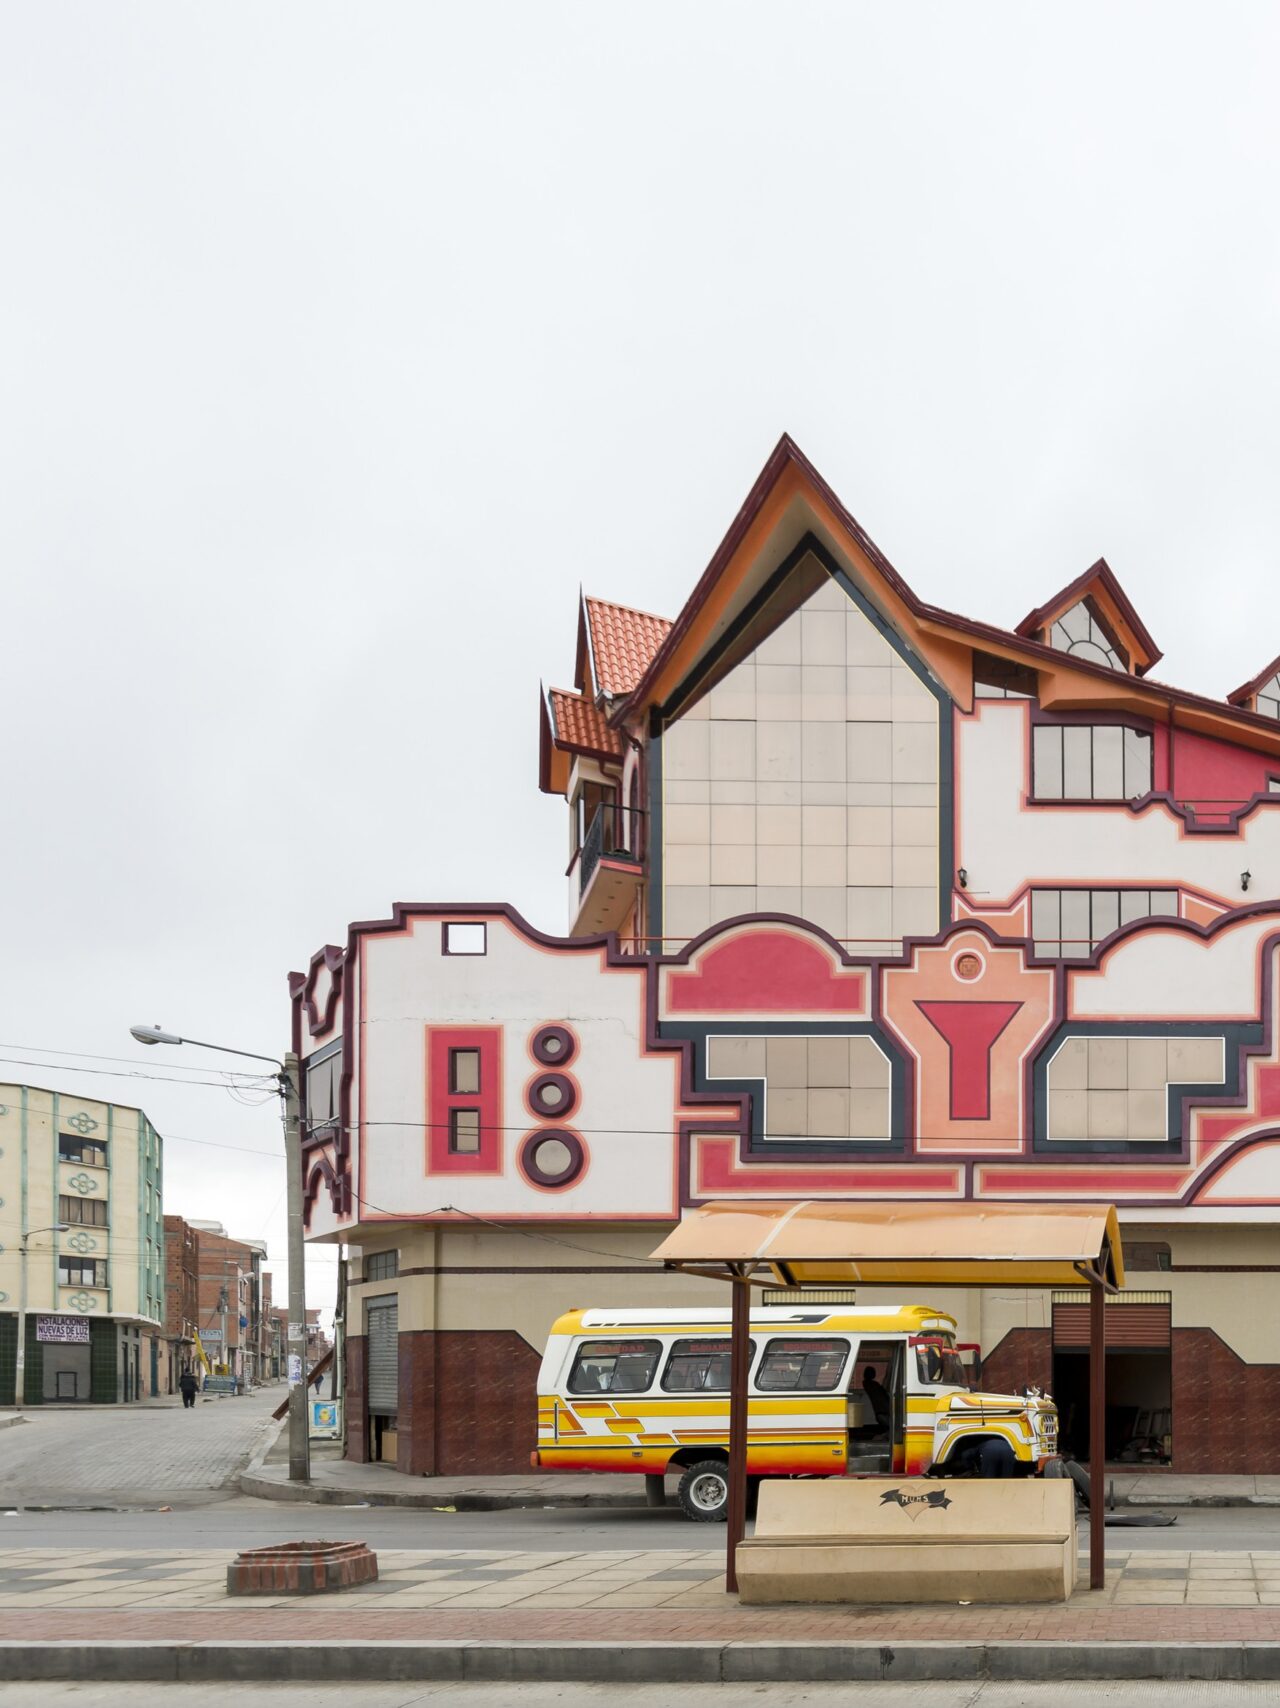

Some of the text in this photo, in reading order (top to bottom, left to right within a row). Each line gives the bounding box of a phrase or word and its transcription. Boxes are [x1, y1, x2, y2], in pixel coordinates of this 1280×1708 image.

[38, 1317, 88, 1326] INSTALACIONES
[38, 1326, 88, 1336] NUEVAS DE LUZ
